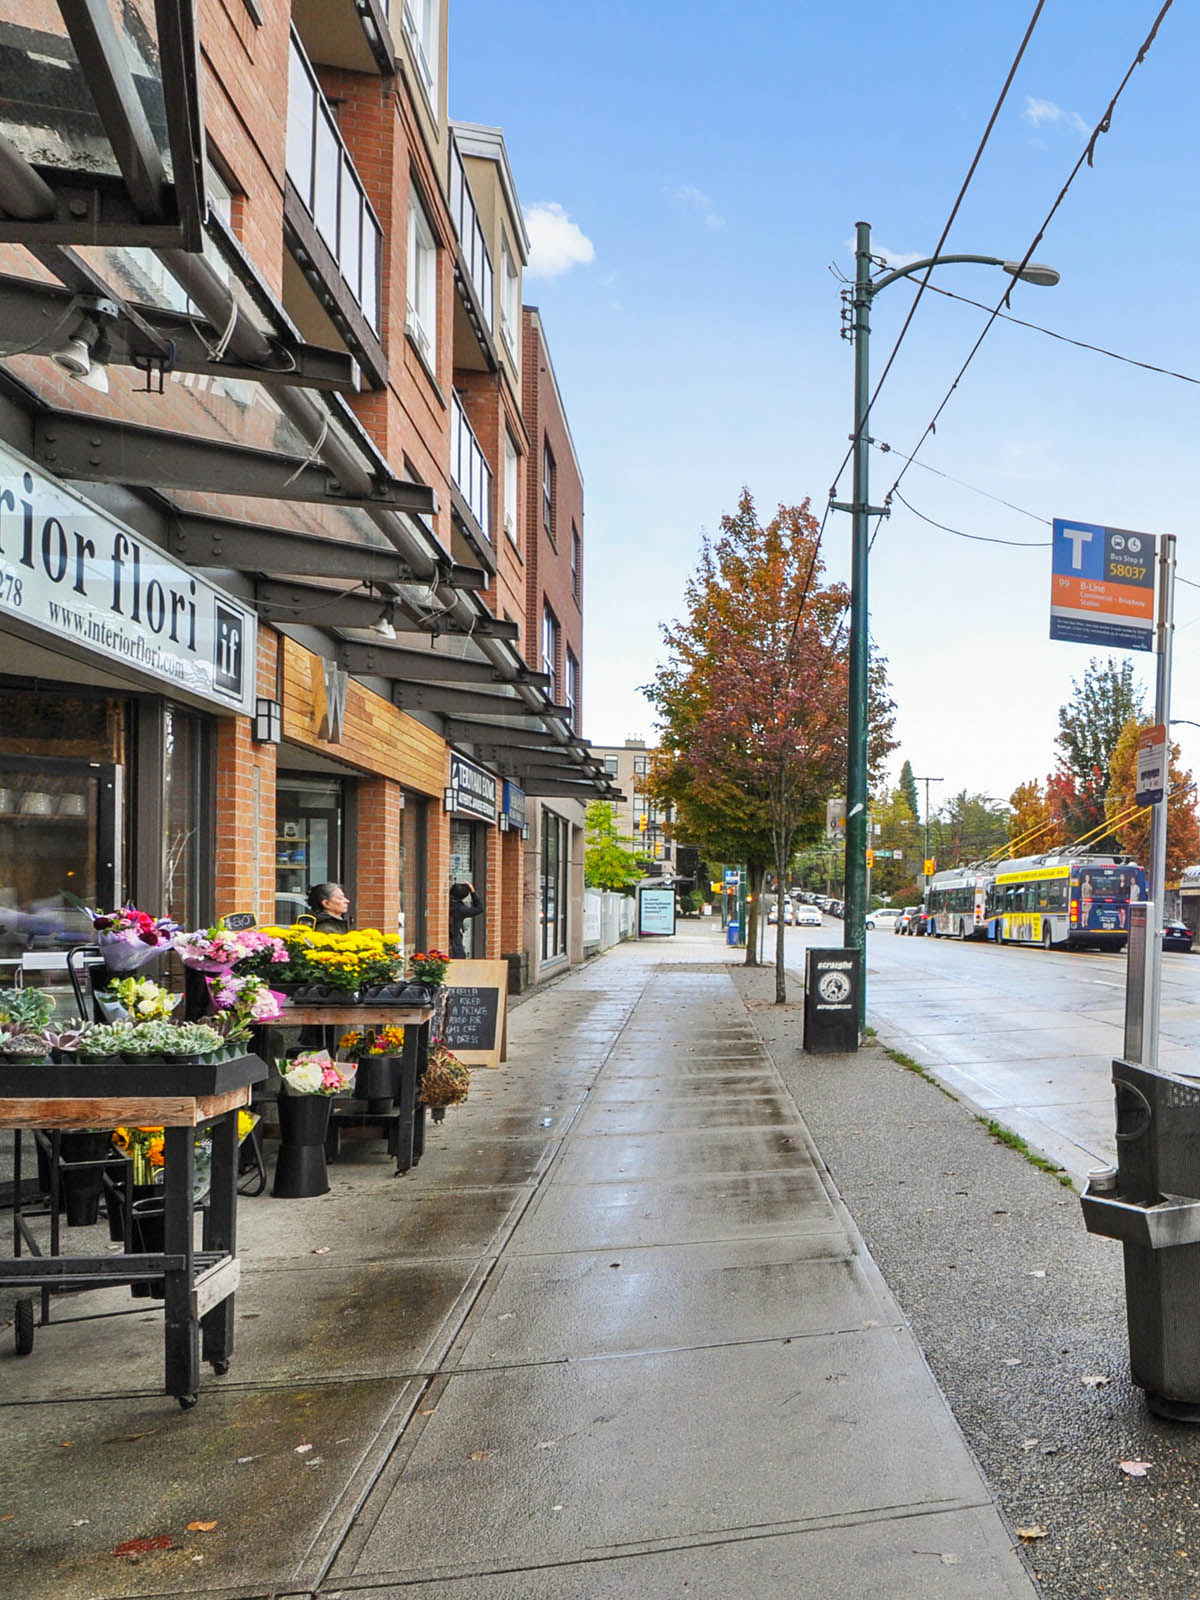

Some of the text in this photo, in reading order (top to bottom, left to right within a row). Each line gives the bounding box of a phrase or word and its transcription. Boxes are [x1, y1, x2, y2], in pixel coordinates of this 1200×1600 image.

[1063, 528, 1093, 570] T
[1110, 552, 1122, 561] Bus
[1123, 554, 1138, 564] Stop
[1110, 562, 1147, 580] 58037
[111, 533, 197, 652] flori
[1080, 581, 1106, 594] B-Line
[49, 600, 185, 680] www.interiorflori.com
